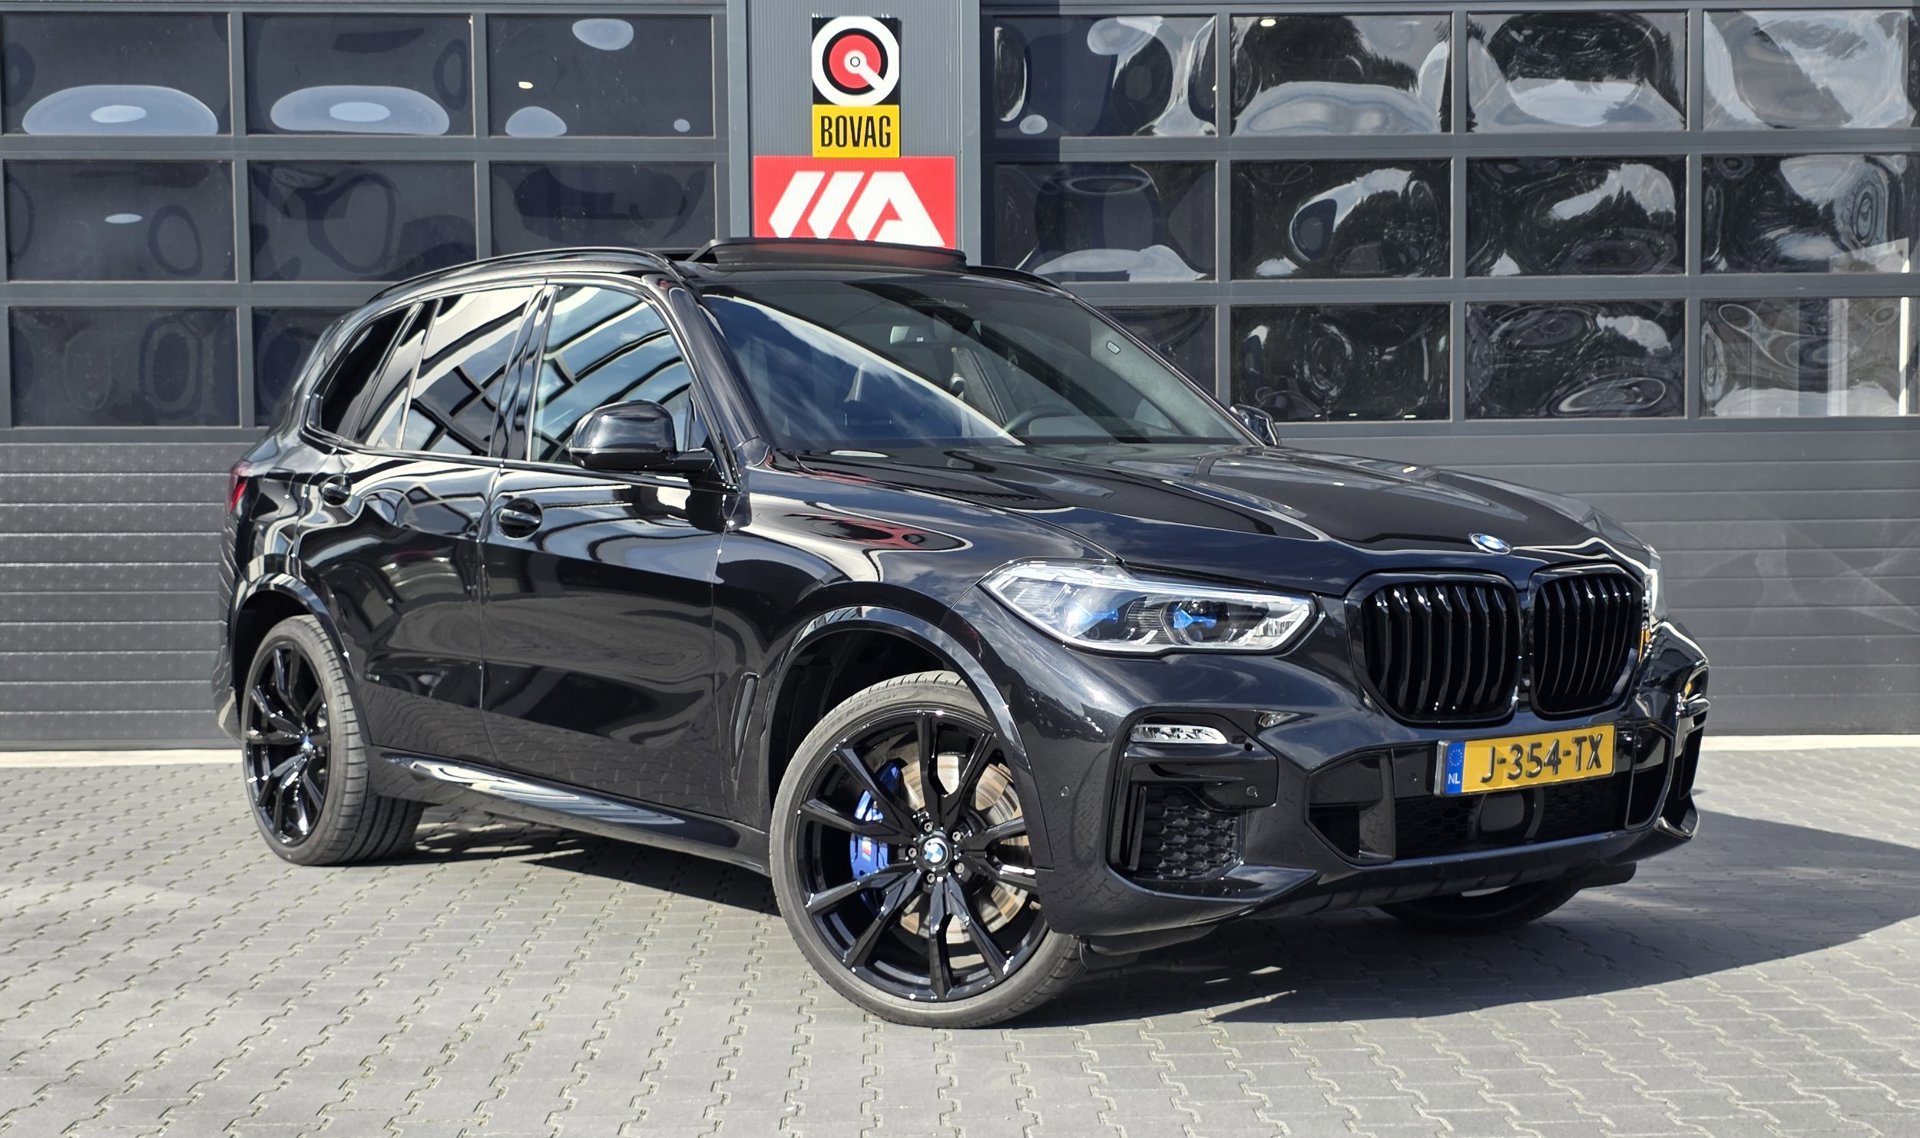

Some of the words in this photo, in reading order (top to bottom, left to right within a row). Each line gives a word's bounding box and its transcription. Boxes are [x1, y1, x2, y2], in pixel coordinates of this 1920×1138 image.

[820, 115, 892, 148] BOVAG
[1480, 733, 1603, 784] J-354-TX
[1447, 772, 1461, 785] NL
